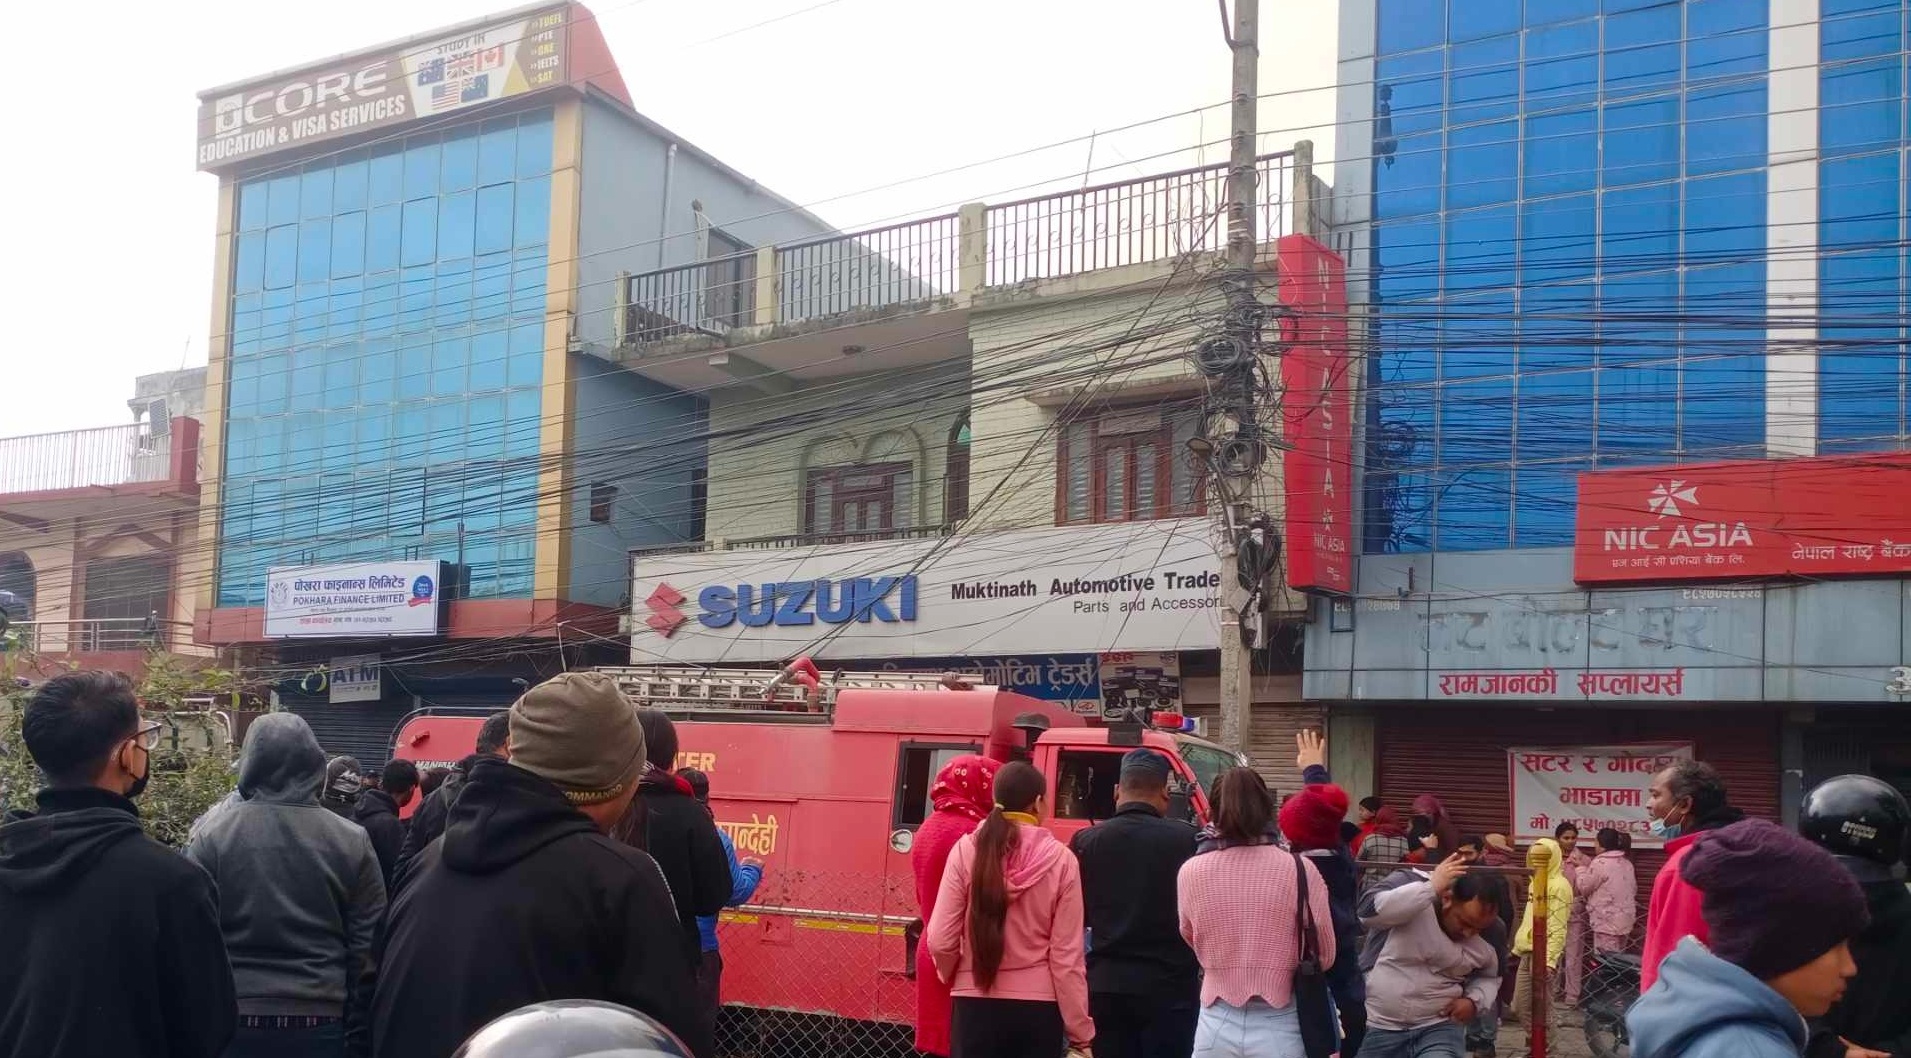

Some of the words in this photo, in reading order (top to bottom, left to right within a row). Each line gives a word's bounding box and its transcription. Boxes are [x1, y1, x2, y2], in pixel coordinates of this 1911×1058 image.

[437, 37, 471, 55] STUDY
[538, 55, 560, 69] IELTS
[538, 71, 553, 83] SAT
[200, 126, 275, 163] EDUCATION
[278, 126, 289, 143] &
[292, 114, 327, 138] VISA
[330, 94, 405, 131] SERVICES
[1604, 526, 1660, 551] NIC
[1668, 521, 1754, 549] ASIA
[1792, 542, 1836, 560] नेपाल
[1840, 544, 1875, 560] राष्ट्र
[1630, 556, 1649, 568] आई
[1653, 556, 1667, 567] सी
[294, 578, 321, 592] पोखरा
[323, 578, 366, 592] फाइनान्स
[368, 575, 407, 590] लिमिटेड
[951, 579, 1037, 600] Muktinath
[1050, 575, 1155, 596] Automotive
[1163, 570, 1221, 590] Trade
[293, 595, 332, 606] POKHARA
[334, 594, 369, 605] FINANCE
[371, 593, 405, 604] LIMITED
[698, 574, 917, 628] SUZUKI
[1073, 600, 1110, 614] Parts
[1119, 598, 1146, 613] and
[331, 665, 379, 684] ATM
[1047, 657, 1094, 692] ट्रेडर्स
[1439, 668, 1558, 696] रामजानकी
[1577, 667, 1685, 697] सप्लायर्स
[1521, 753, 1573, 774] सटर
[1583, 754, 1600, 774] र
[563, 783, 623, 801] OMMANDO
[1559, 786, 1642, 807] भाडामा
